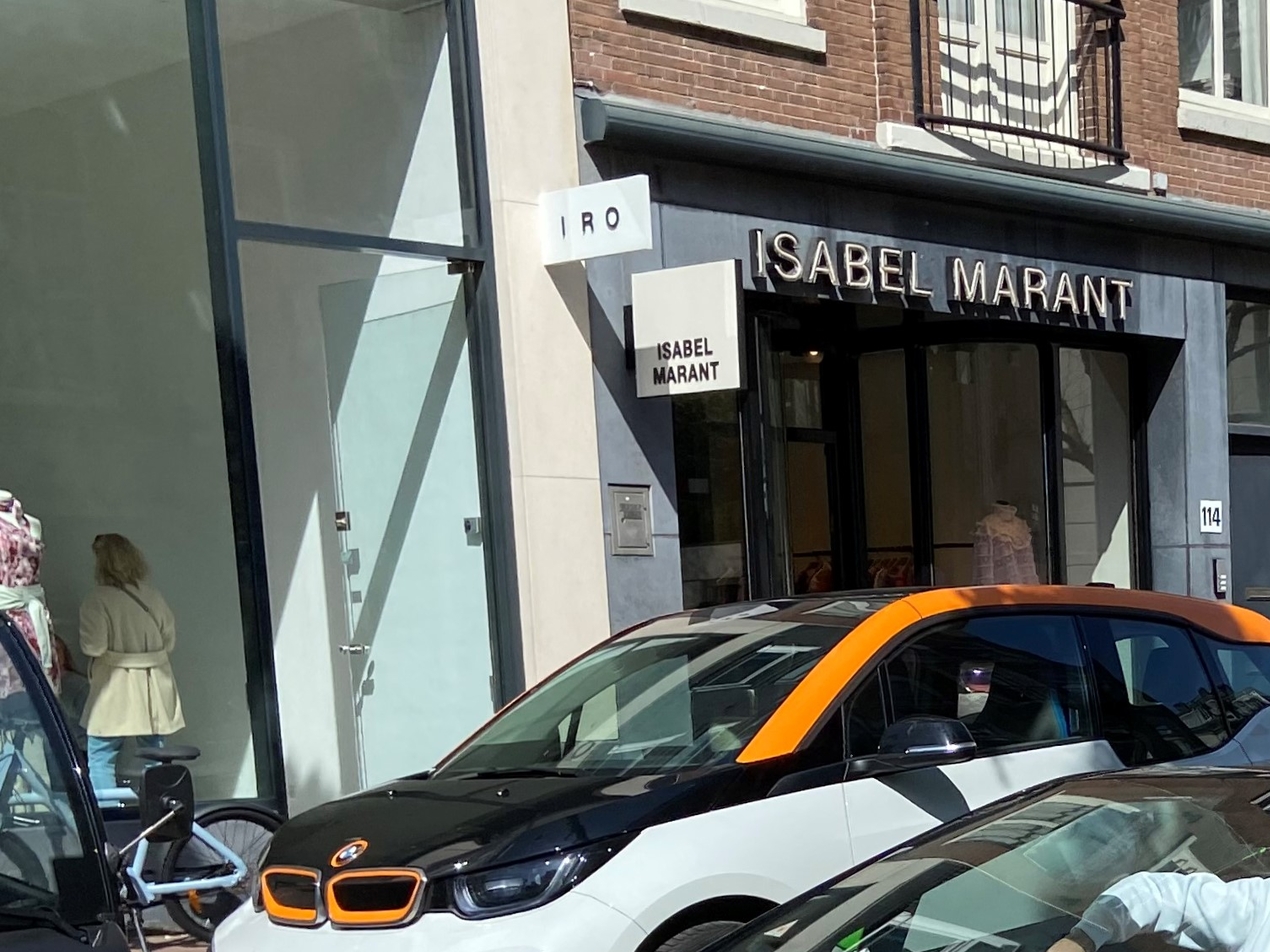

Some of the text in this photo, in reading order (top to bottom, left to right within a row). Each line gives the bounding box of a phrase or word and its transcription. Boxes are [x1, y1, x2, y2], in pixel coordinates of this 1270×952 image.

[560, 206, 620, 240] IRO
[751, 228, 1134, 320] ISABEL MARANT
[656, 337, 713, 361] ISABEL
[653, 361, 720, 386] MARANT
[1201, 506, 1221, 527] 114
